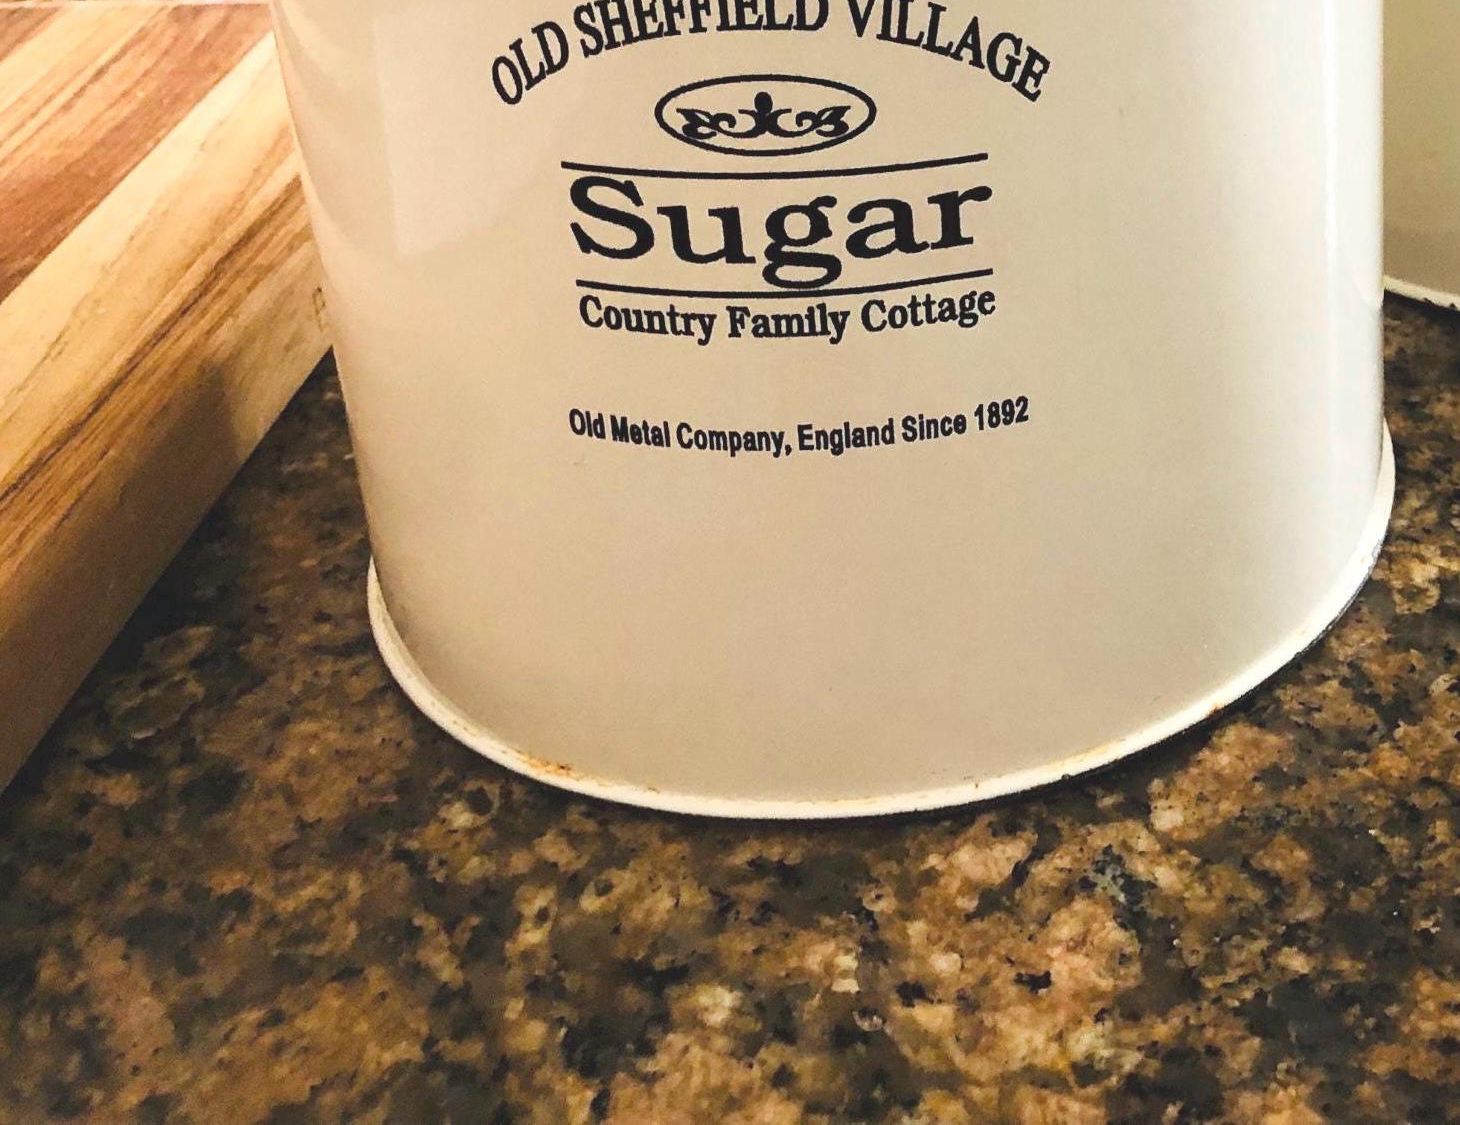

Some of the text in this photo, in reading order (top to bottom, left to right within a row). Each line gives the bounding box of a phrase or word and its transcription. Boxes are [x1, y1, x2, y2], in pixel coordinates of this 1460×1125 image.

[491, 20, 570, 106] OLD
[569, 175, 993, 291] Sugar
[579, 290, 996, 347] Country Family Cottage
[568, 395, 1029, 459] Old Metal Company, England Since 1892
